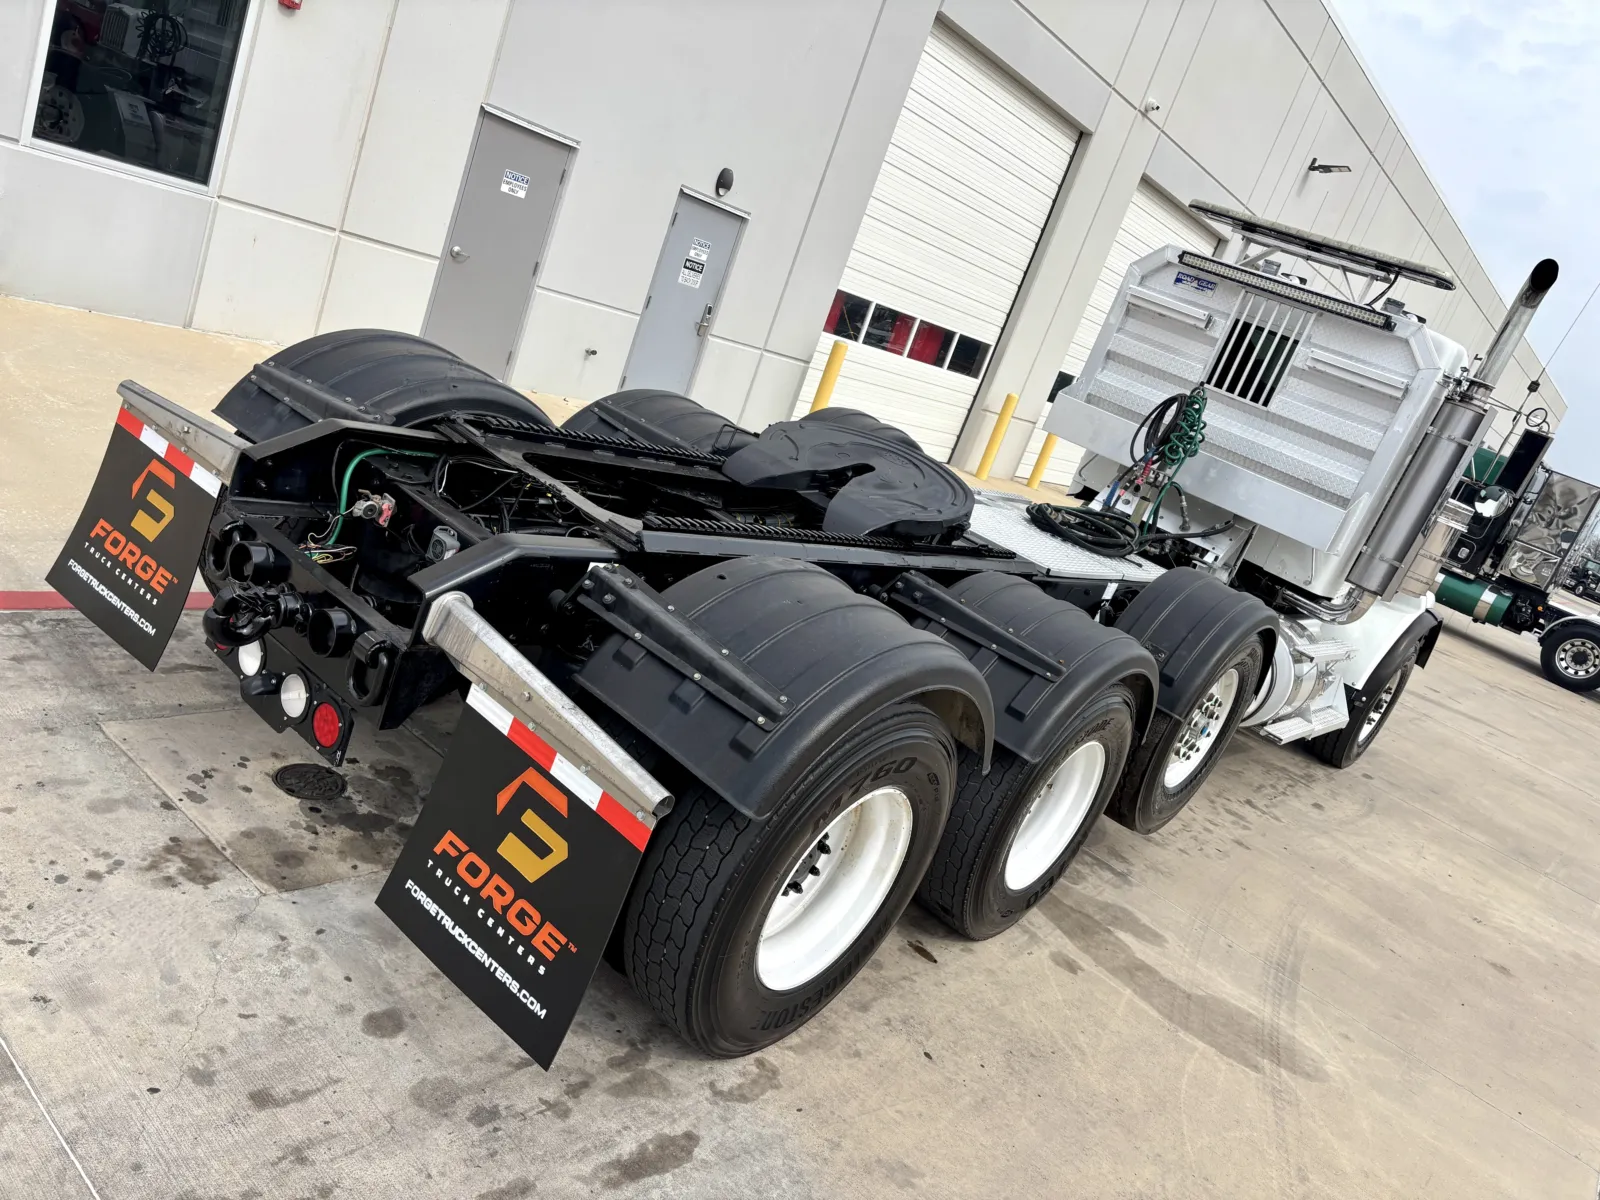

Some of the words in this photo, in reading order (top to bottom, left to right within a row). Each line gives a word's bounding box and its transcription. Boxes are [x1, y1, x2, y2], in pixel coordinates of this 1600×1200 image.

[502, 179, 528, 192] EMPLOYEES
[504, 170, 530, 186] NOTICE
[507, 187, 519, 195] ONLY
[693, 239, 711, 250] NOTICE
[685, 260, 704, 272] NOTICE
[1177, 273, 1195, 284] ROAD
[1198, 280, 1216, 290] GEAR
[84, 541, 112, 569] TRUCK
[115, 568, 159, 606] CENTERS
[89, 518, 172, 594] FORGE
[67, 558, 157, 637] FORGETRUCKCENTERS.COM
[432, 829, 568, 962] FORGE
[427, 859, 471, 906] TRUCK
[477, 907, 546, 976] CENTERS
[404, 878, 548, 1020] FORGETRUCKCENTERS.COM
